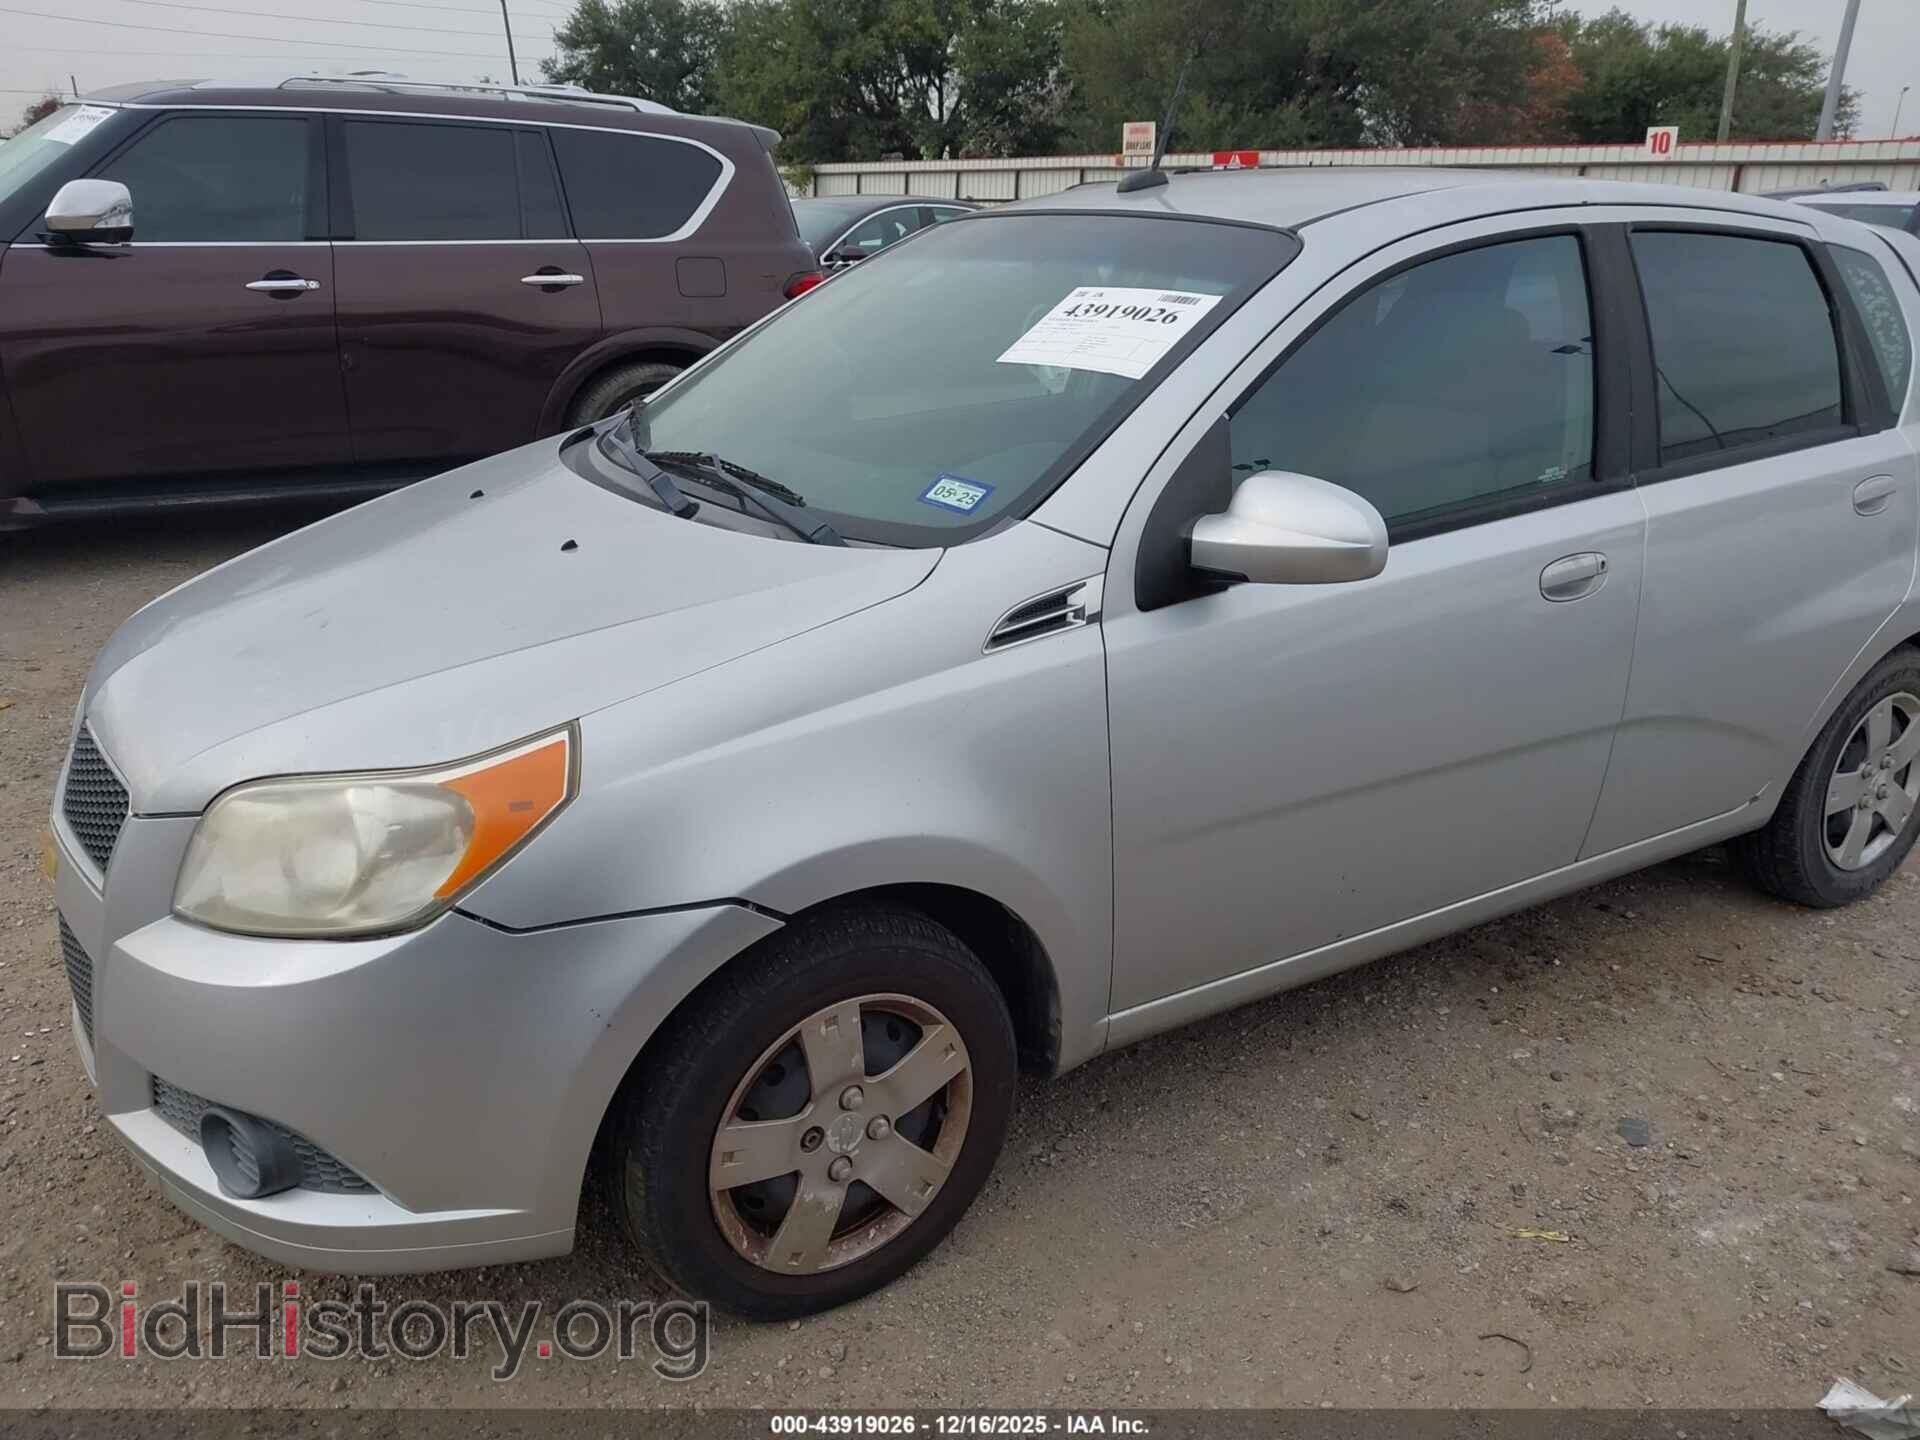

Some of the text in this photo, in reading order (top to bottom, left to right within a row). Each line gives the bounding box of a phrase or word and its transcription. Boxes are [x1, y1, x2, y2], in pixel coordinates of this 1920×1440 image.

[1649, 131, 1671, 154] 10
[1063, 303, 1179, 325] 43919026
[933, 485, 979, 505] 05 25
